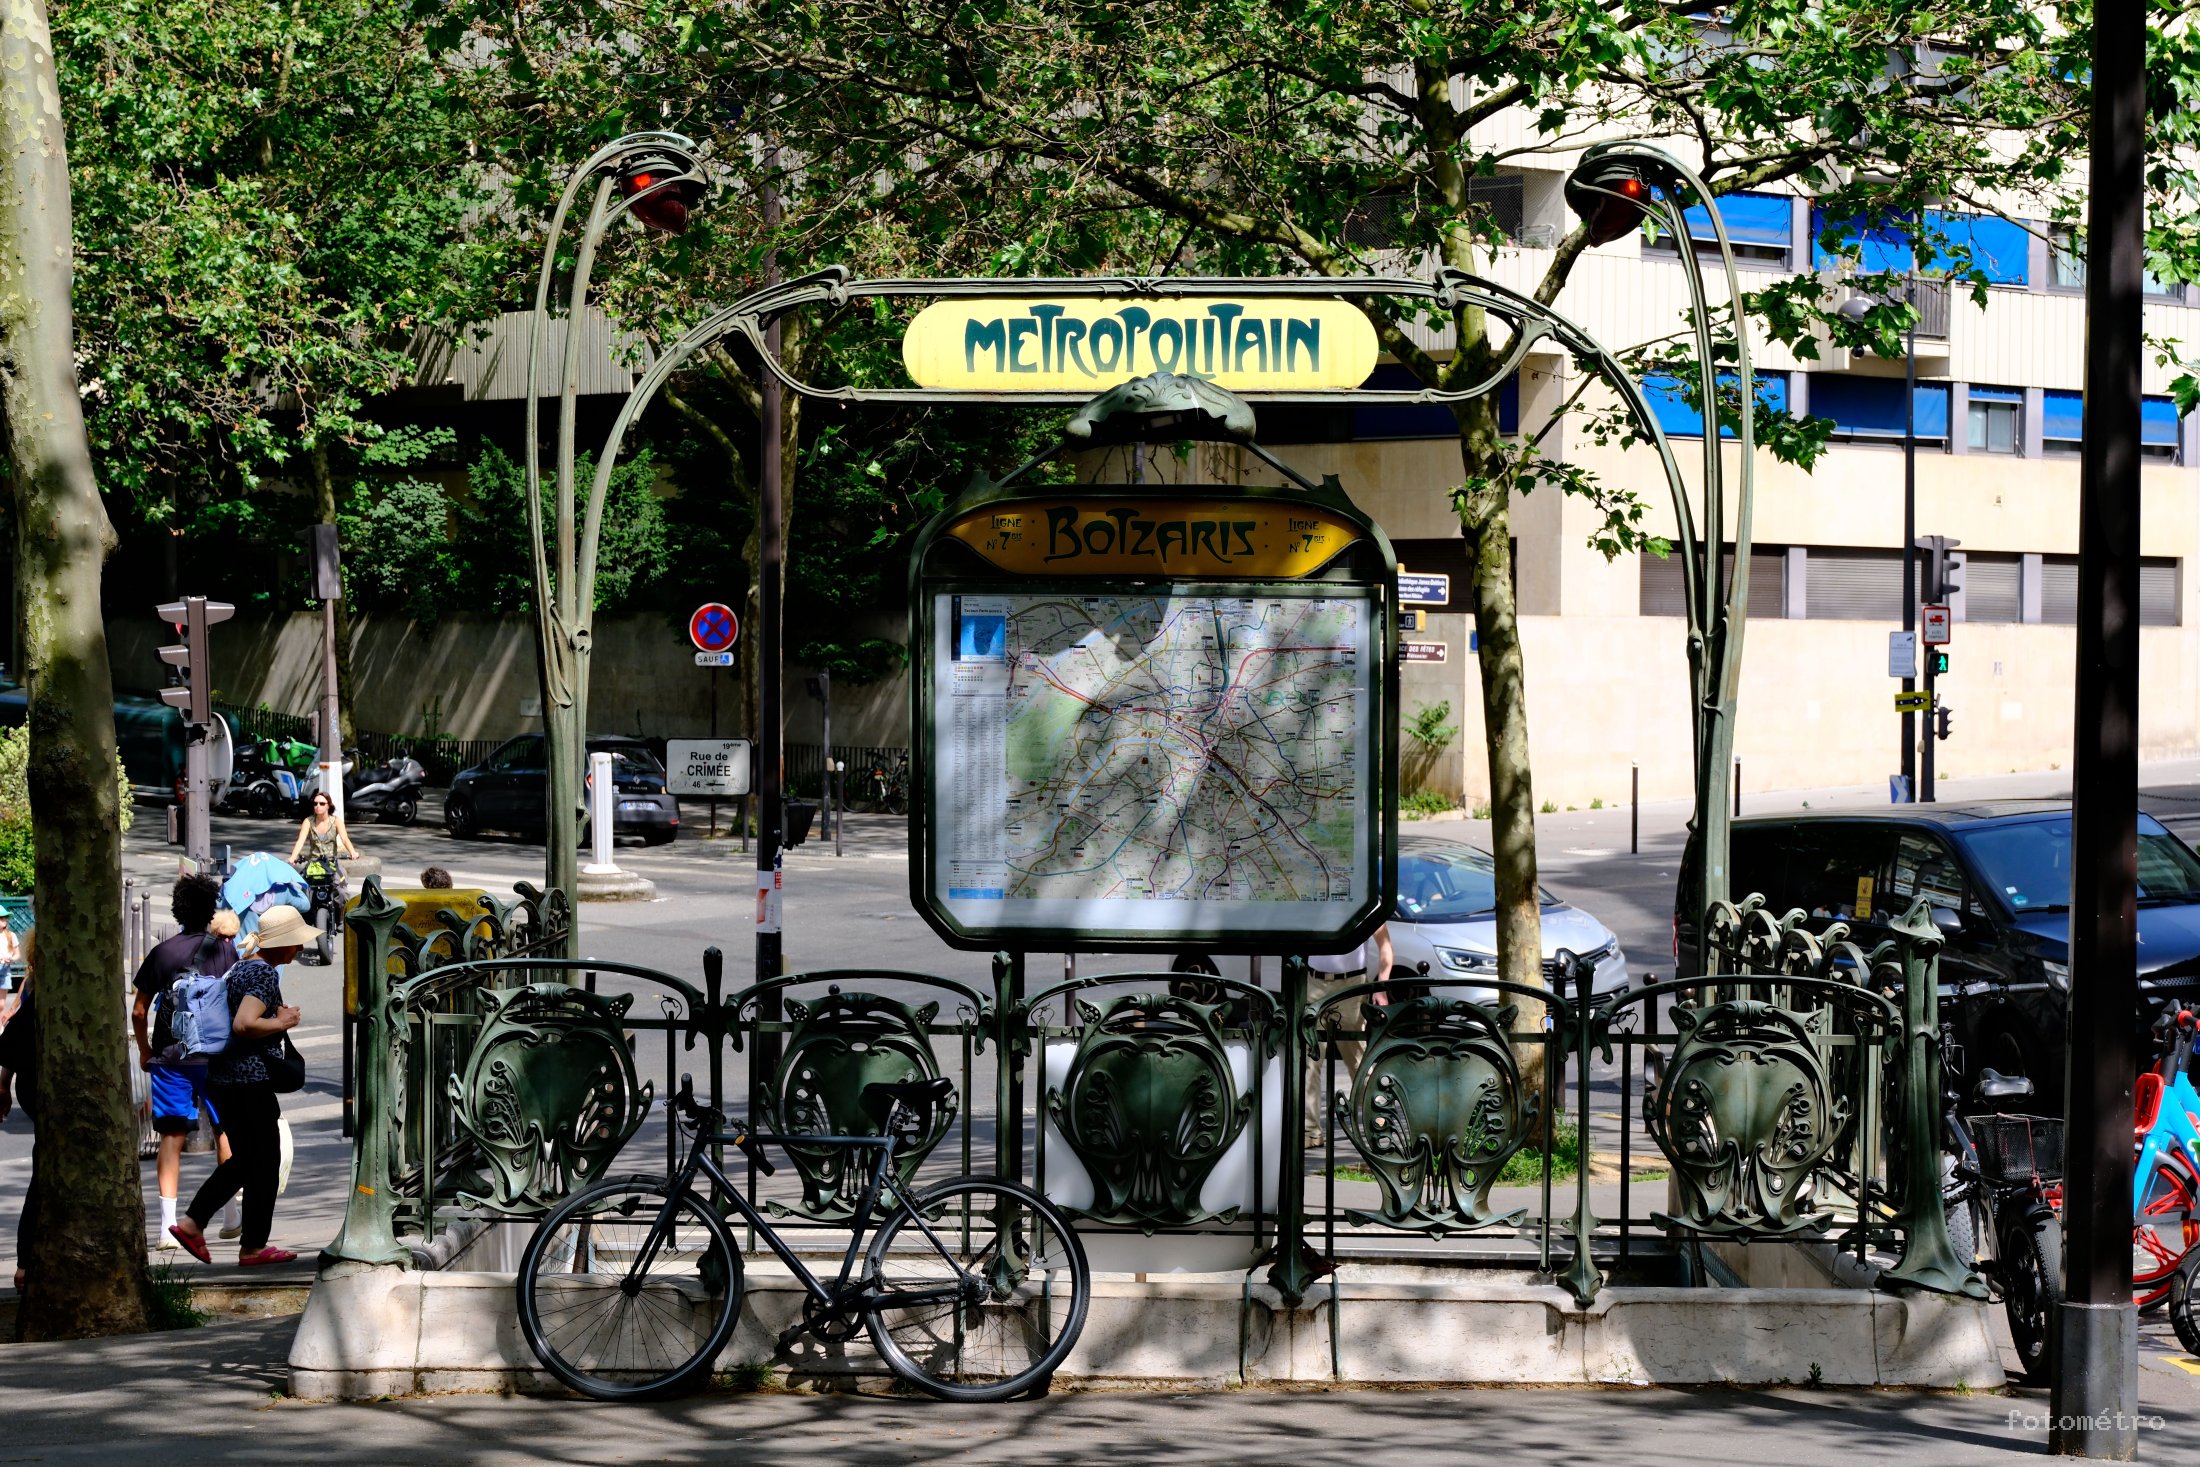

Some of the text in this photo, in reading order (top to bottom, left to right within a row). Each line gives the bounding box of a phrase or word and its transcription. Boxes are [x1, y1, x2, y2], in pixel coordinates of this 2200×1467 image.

[964, 303, 1321, 379] METROPOLITAIN
[991, 514, 1022, 529] LIGNE
[1288, 517, 1320, 531] LIGNE
[1043, 505, 1257, 564] BOTZARIS
[697, 655, 719, 663] SAUF
[690, 751, 728, 761] Rue de
[687, 763, 731, 777] CRIMÉE
[692, 780, 701, 788] 46
